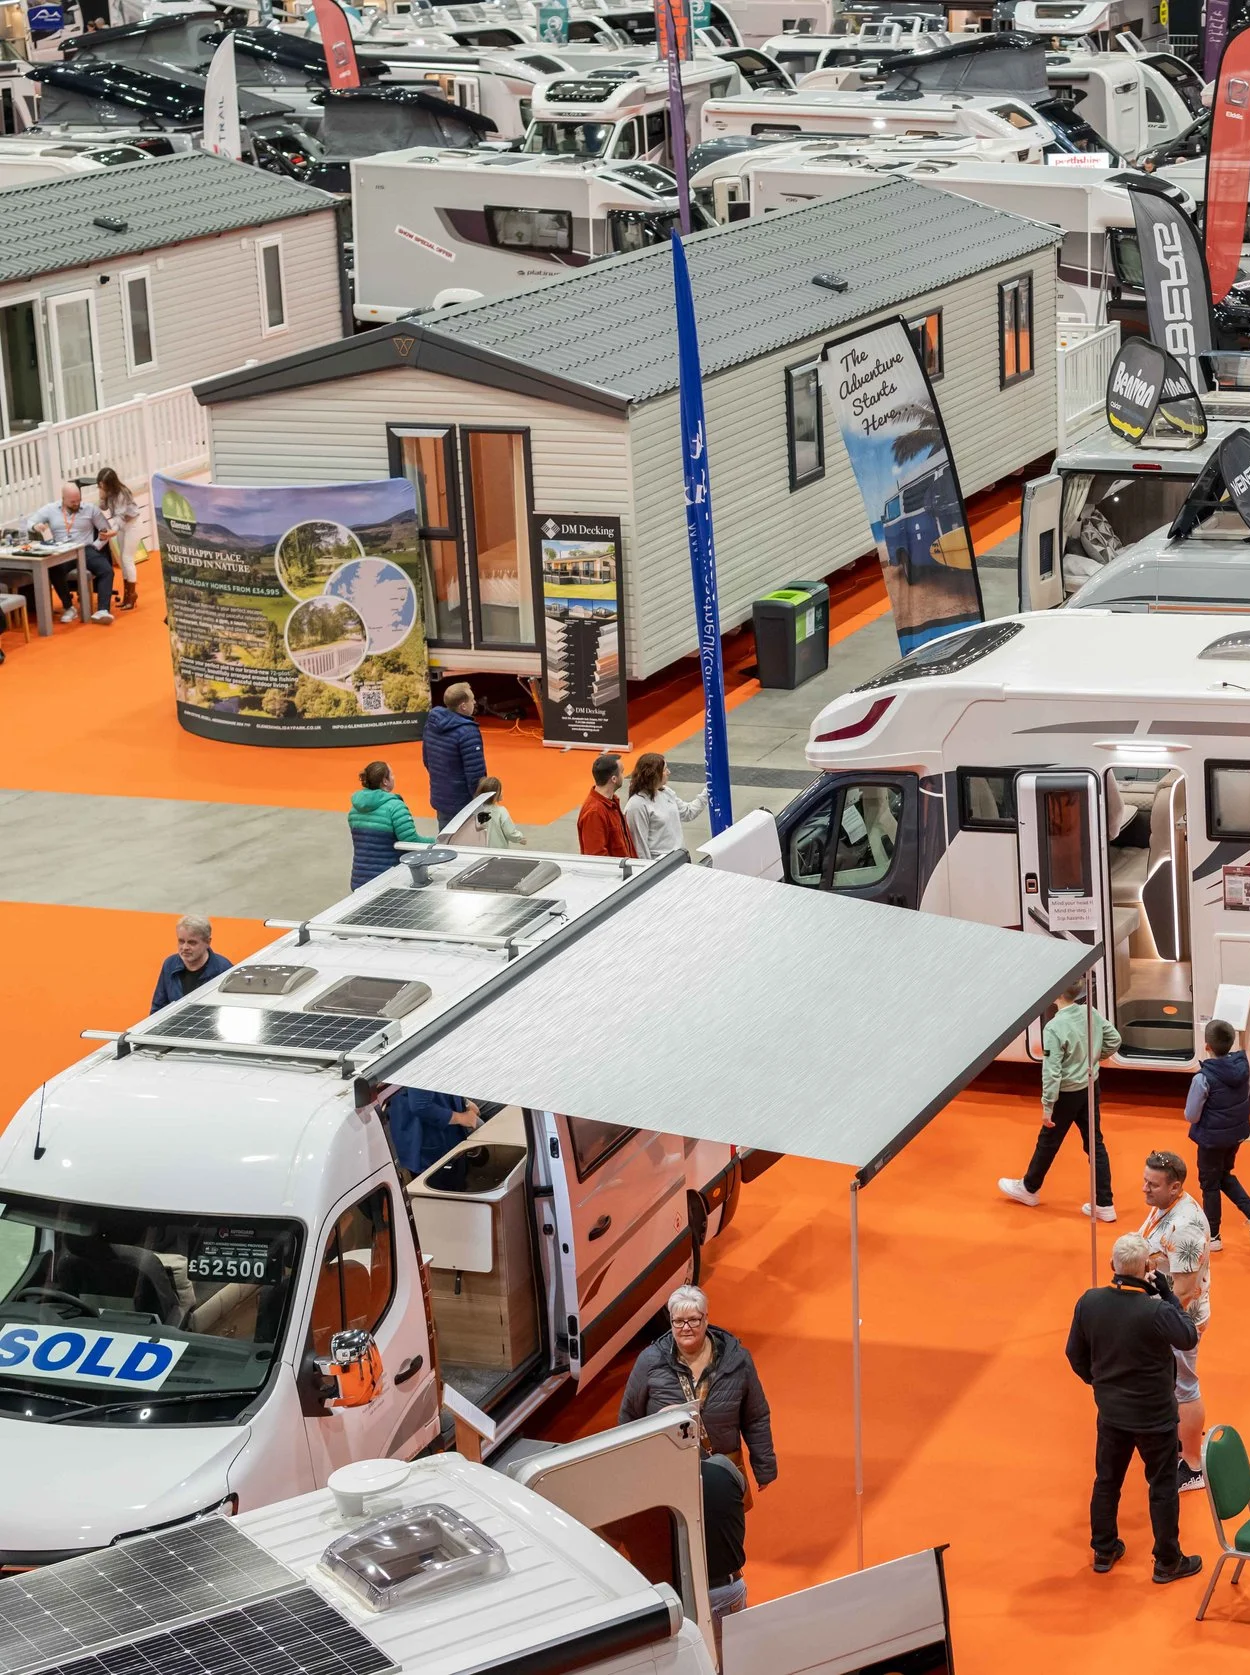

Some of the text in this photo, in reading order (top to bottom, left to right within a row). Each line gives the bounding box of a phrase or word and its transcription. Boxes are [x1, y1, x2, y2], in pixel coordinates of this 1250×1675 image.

[218, 95, 226, 143] TRAIL
[840, 348, 868, 373] The
[839, 353, 904, 400] Adventure
[852, 381, 898, 417] Starts
[561, 524, 615, 538] DM Decking
[166, 543, 245, 564] YOUR HAPPY PLACE,
[167, 553, 250, 574] NESTLED IN NATURE
[171, 576, 184, 585] NEW
[184, 577, 210, 588] HOLIDAY
[210, 581, 232, 592] HOMES
[232, 584, 251, 593] FROM
[1065, 900, 1076, 908] your
[188, 1259, 265, 1278] £52500
[0, 1330, 173, 1381] SOLD
